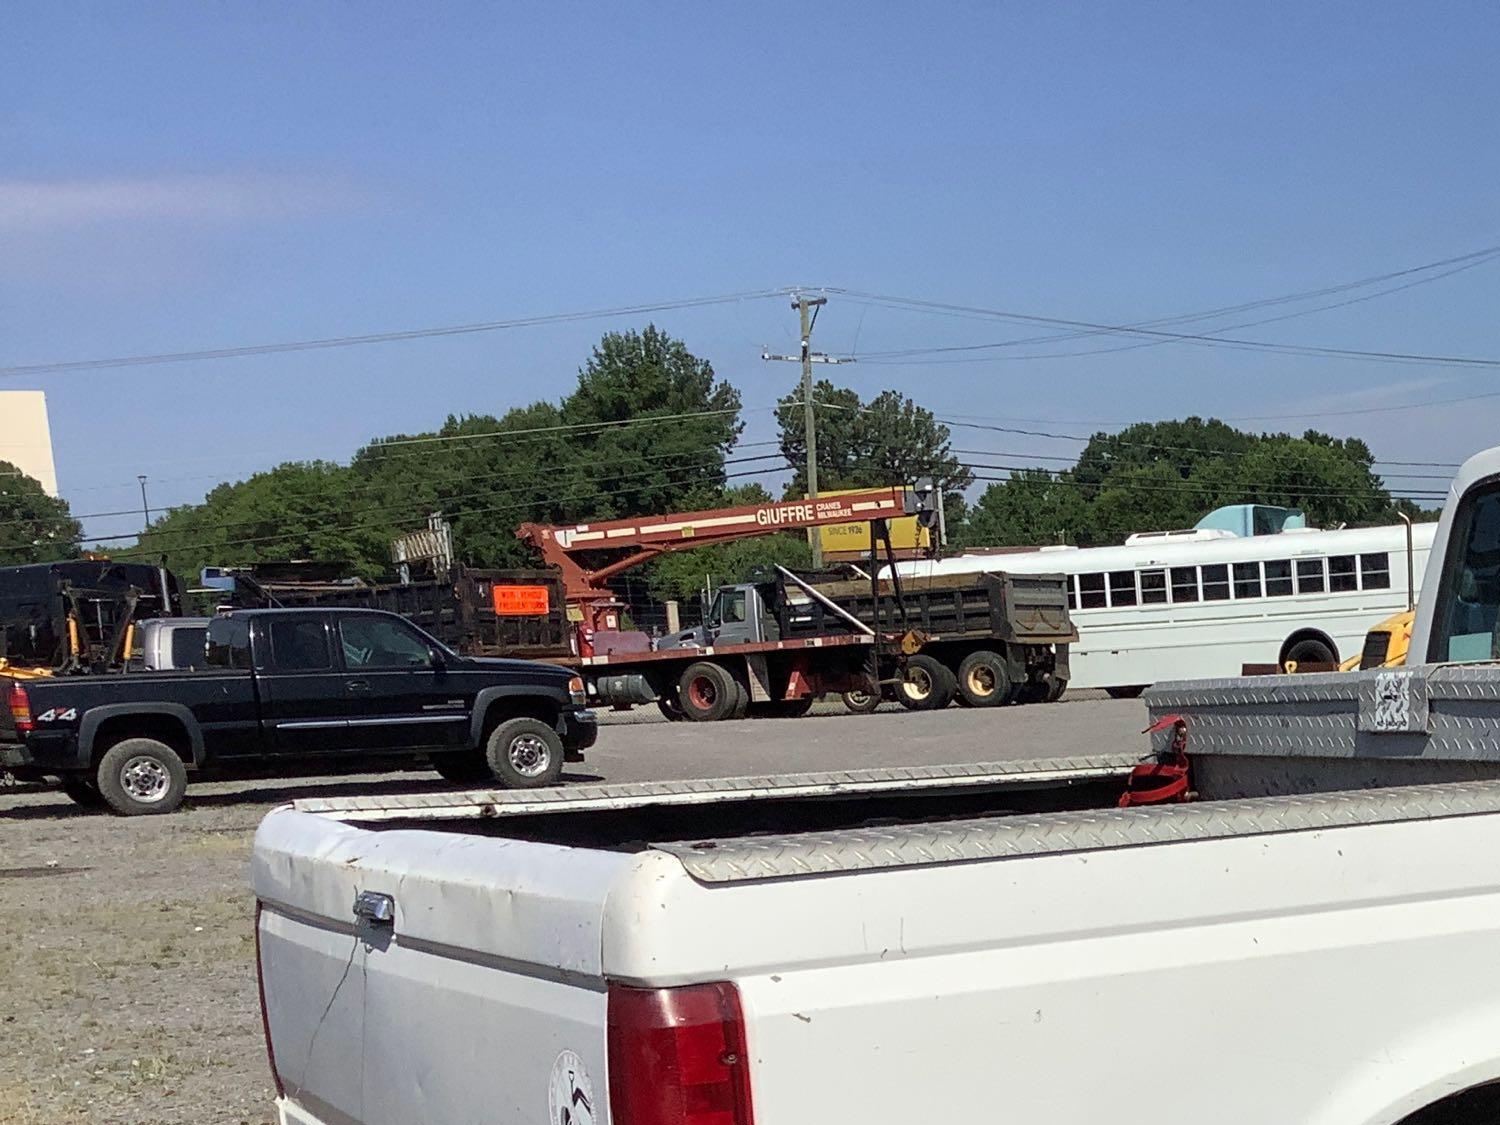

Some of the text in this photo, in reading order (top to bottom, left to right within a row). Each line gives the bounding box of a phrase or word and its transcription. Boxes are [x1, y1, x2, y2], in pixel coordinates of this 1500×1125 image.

[816, 502, 841, 510] CRANES
[757, 505, 814, 525] GIUFFRE
[817, 509, 852, 519] MILWAUKEE
